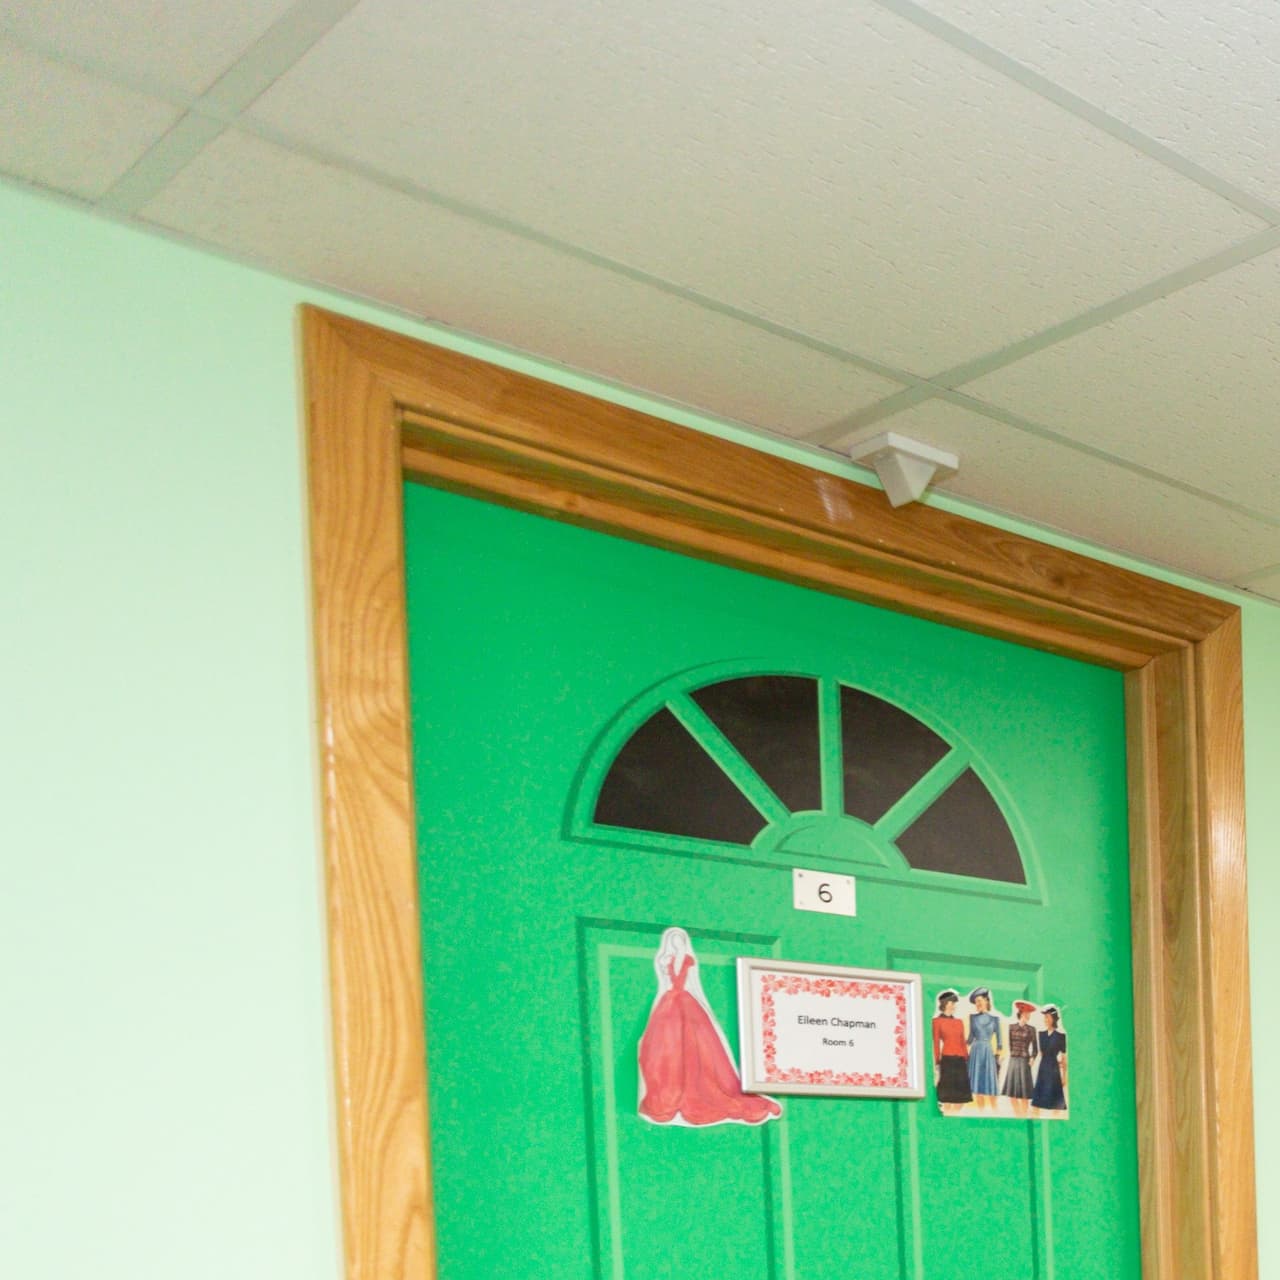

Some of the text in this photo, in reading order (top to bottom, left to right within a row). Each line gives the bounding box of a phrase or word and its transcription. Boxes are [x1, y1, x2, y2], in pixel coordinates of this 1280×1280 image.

[818, 883, 833, 903] 6
[797, 1015, 877, 1030] Eileen Chapman
[821, 1037, 855, 1047] Room 6
